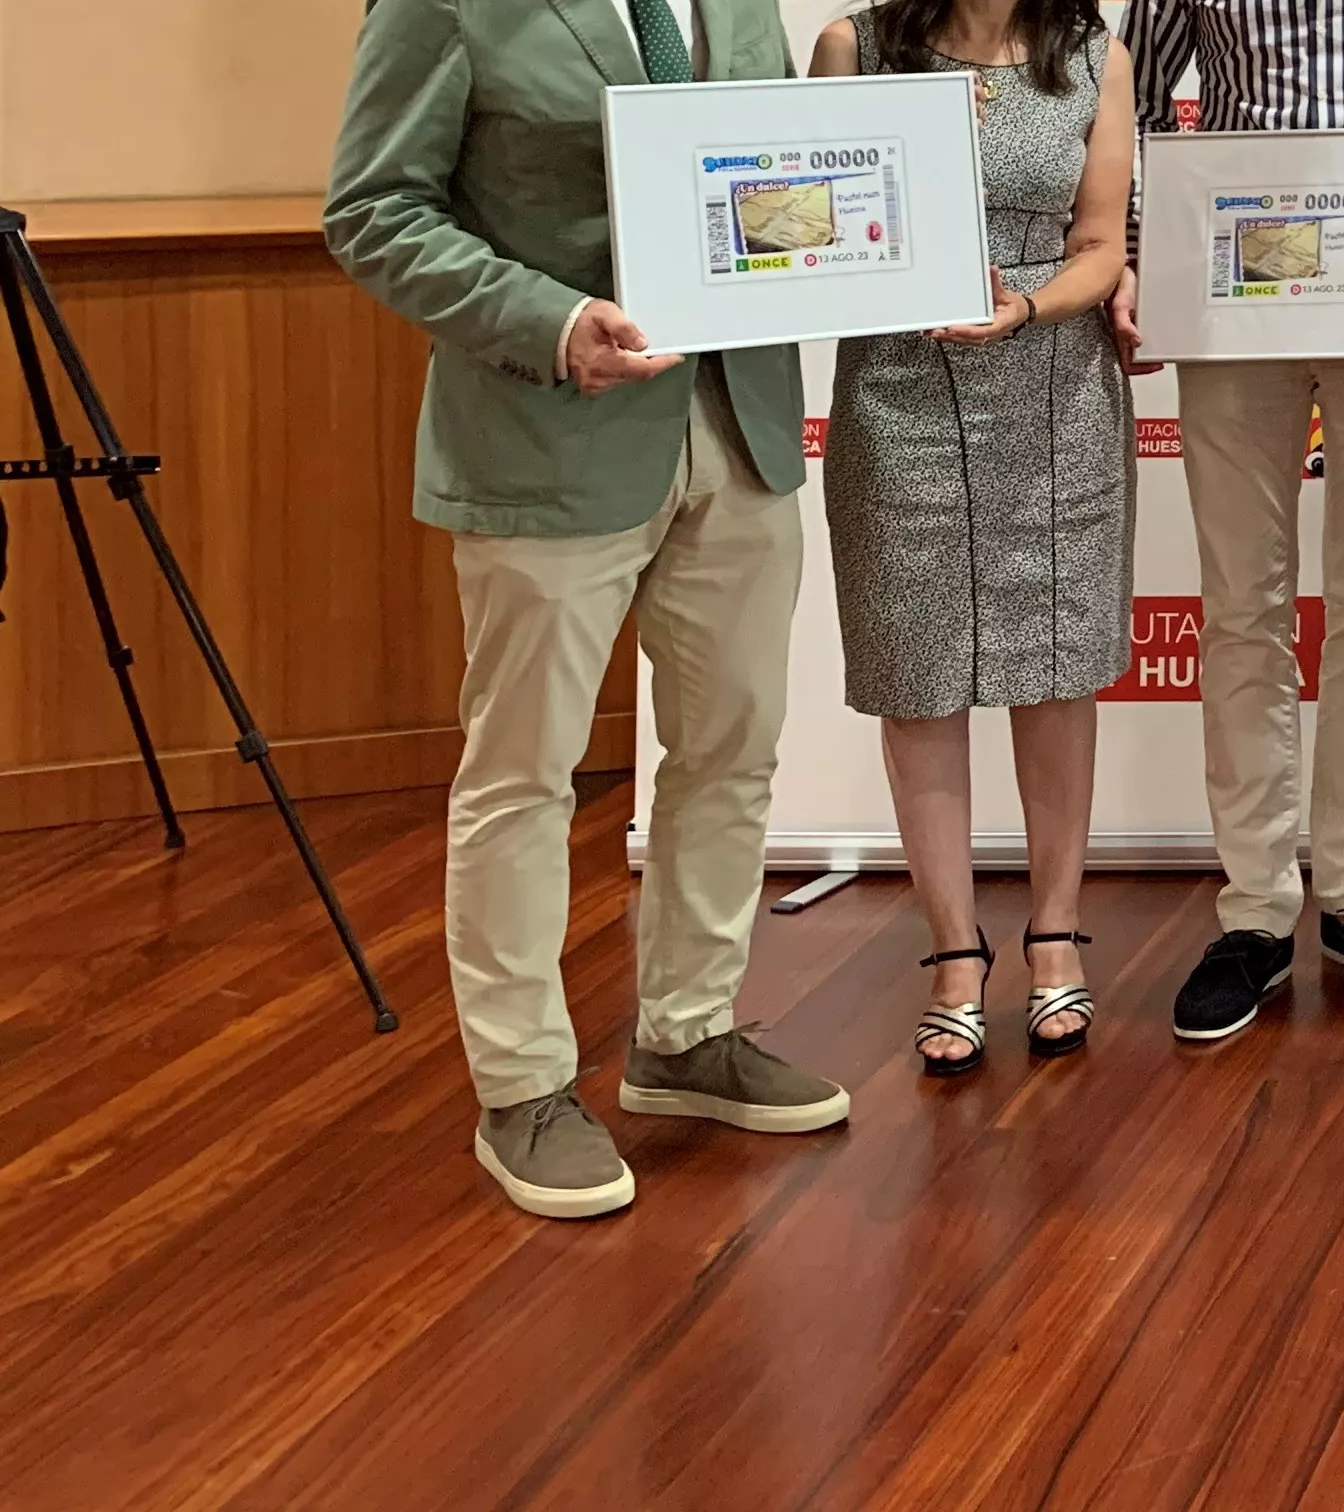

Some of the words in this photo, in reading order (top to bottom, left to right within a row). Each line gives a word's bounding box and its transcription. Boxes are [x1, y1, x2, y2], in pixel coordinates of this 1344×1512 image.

[810, 148, 879, 169] 00000
[858, 252, 868, 260] 23
[752, 258, 788, 269] ONCE
[1138, 440, 1182, 453] HUES
